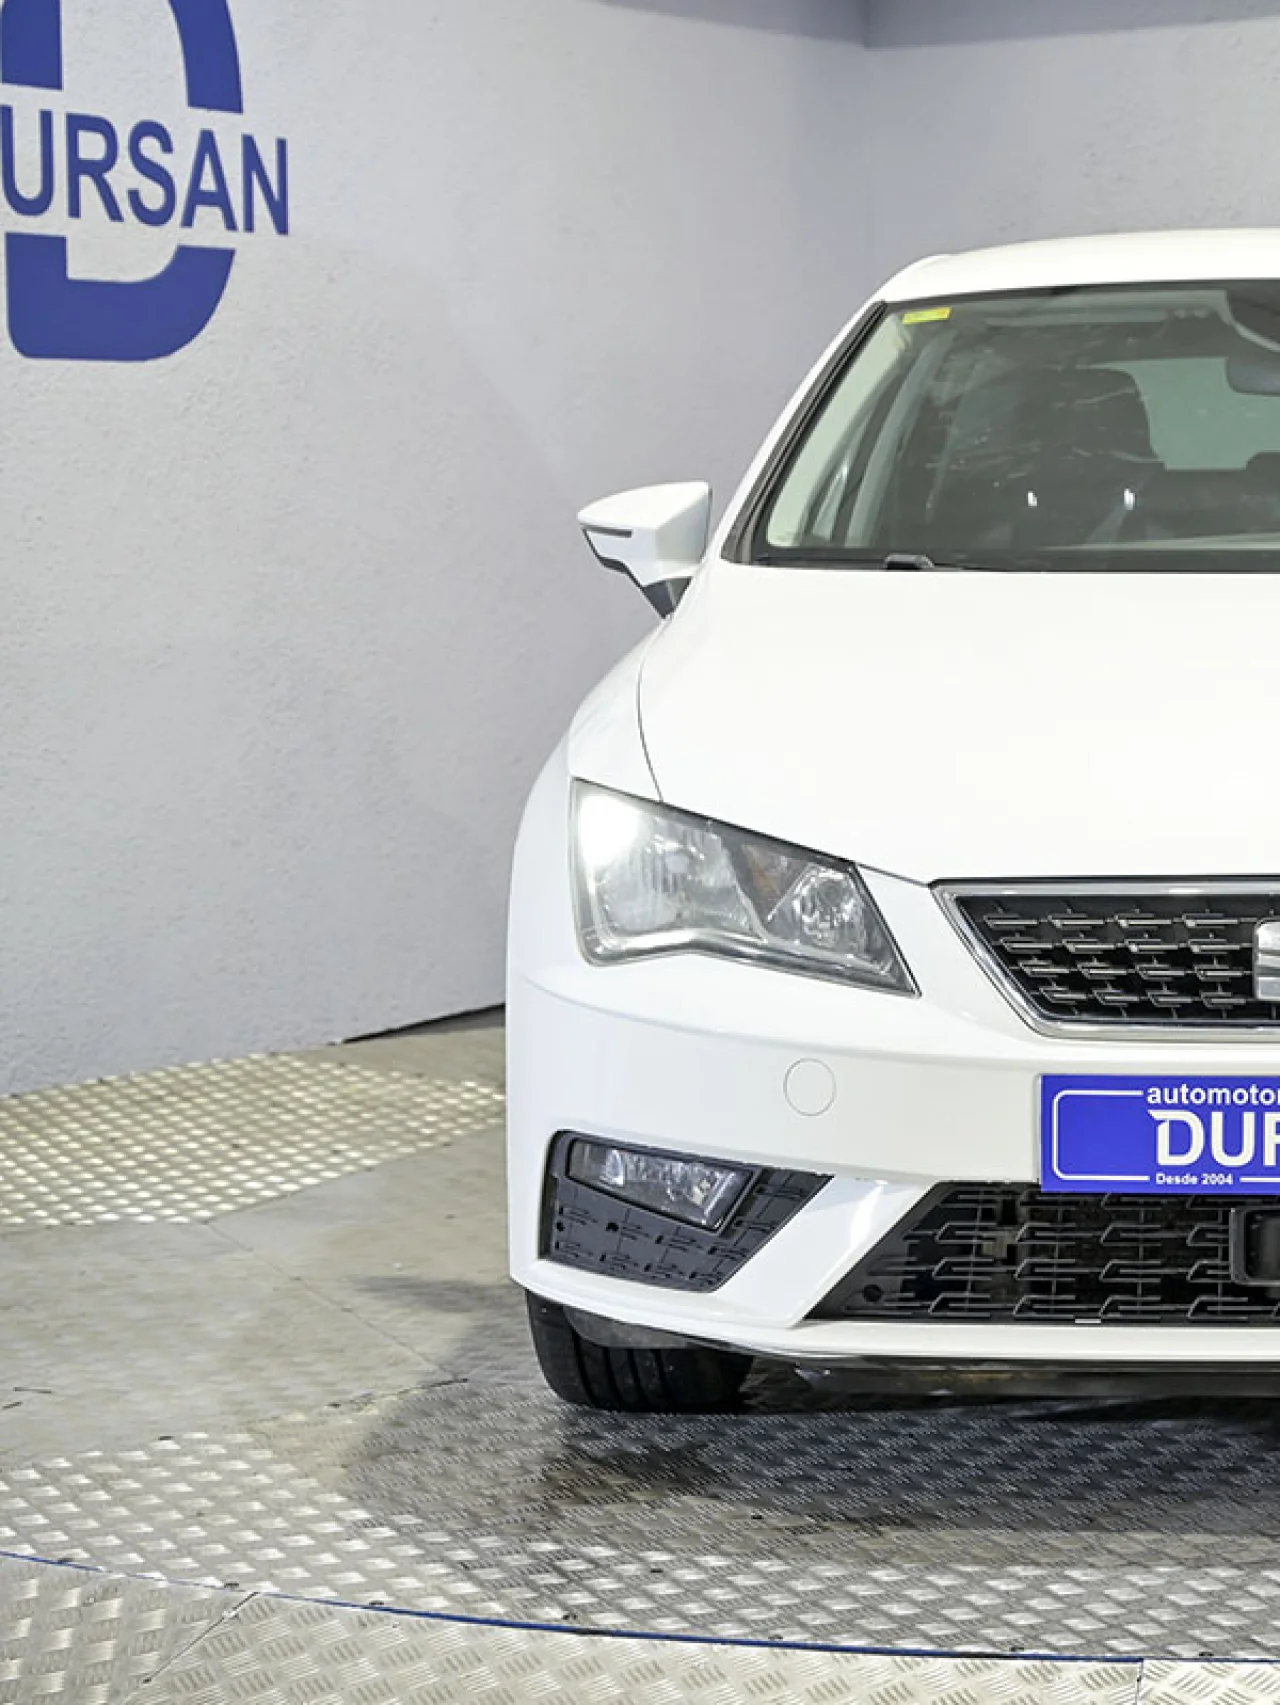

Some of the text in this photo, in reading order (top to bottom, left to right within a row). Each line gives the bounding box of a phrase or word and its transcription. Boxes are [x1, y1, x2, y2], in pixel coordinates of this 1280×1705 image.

[0, 104, 289, 236] URSAN
[1156, 1172, 1234, 1186] Desde 2004
